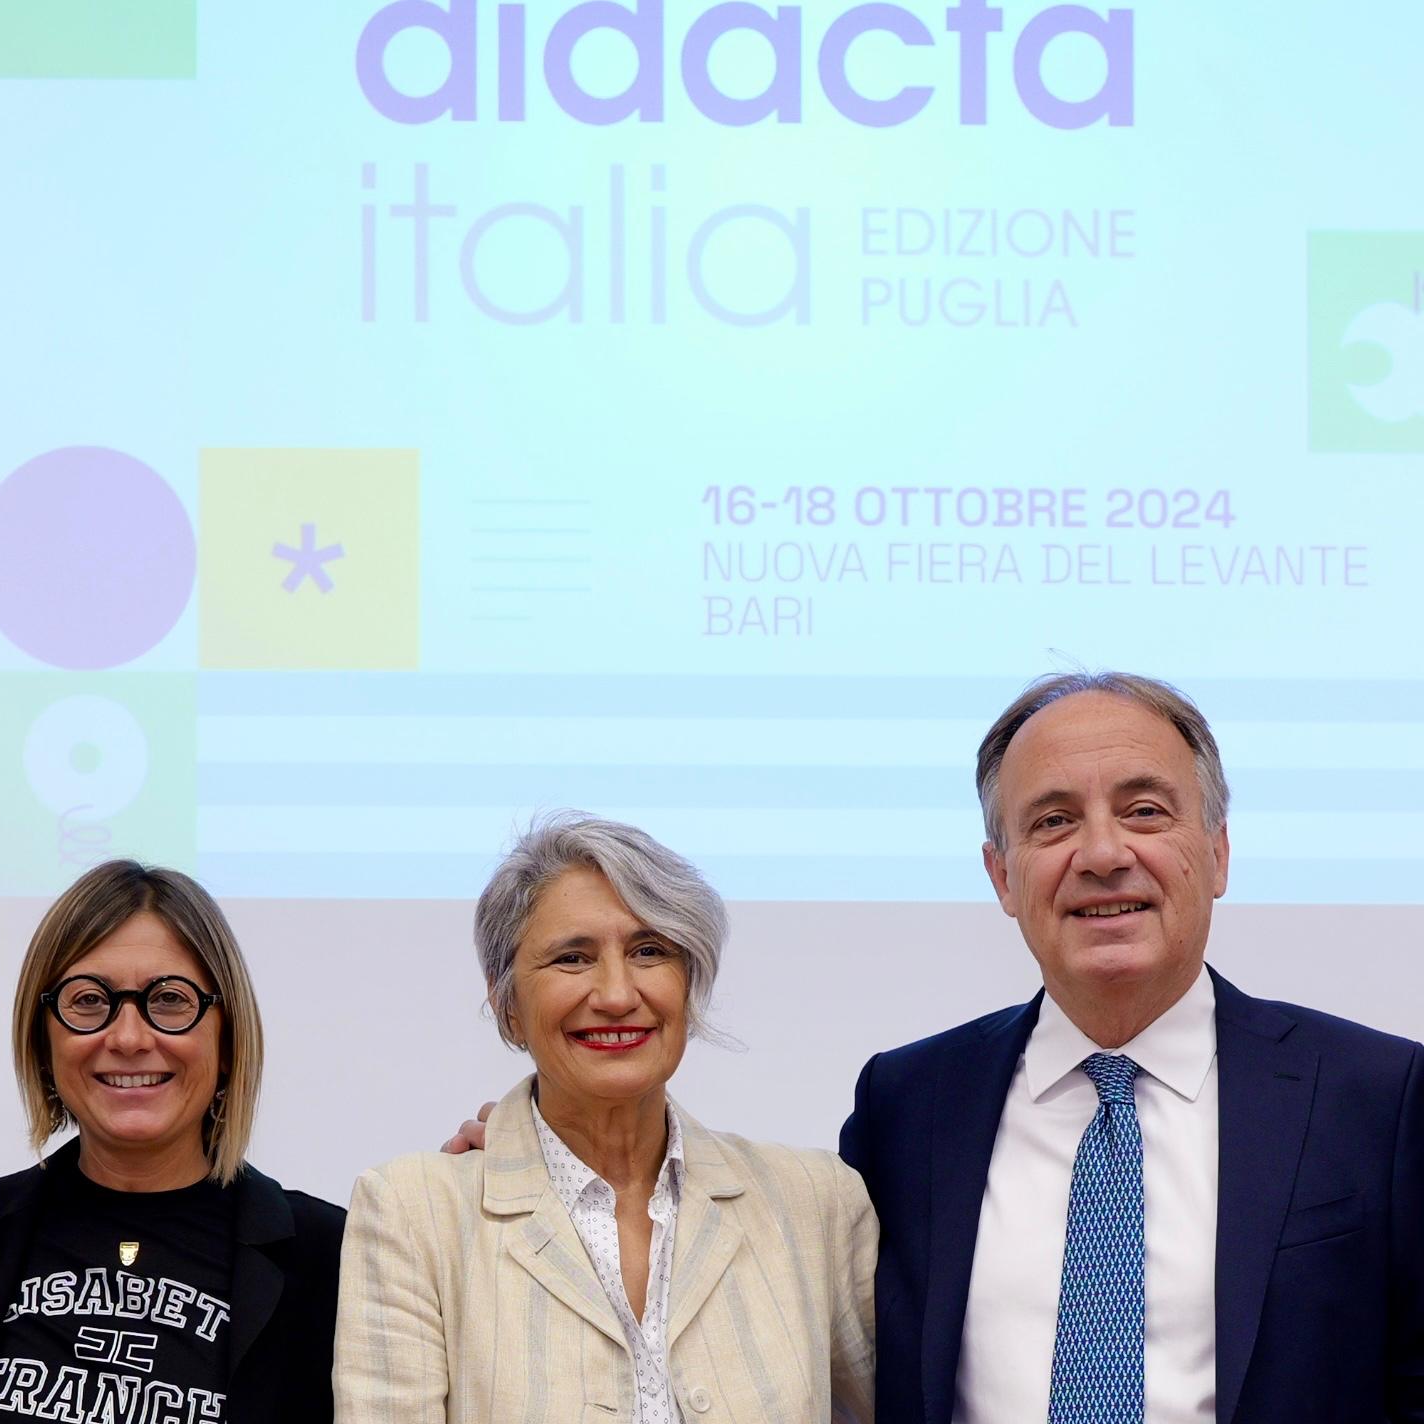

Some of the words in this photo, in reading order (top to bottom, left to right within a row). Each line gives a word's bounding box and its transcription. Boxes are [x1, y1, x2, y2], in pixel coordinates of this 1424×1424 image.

[360, 161, 813, 328] italia
[860, 207, 1137, 259] EDIZIONE
[860, 276, 1080, 329] PUGLIA
[701, 485, 836, 526] 16-18
[853, 487, 1089, 528] OTTOBRE
[1105, 488, 1237, 530] 2024
[701, 542, 869, 584] NUOVA
[886, 543, 1023, 585] FIERA
[1040, 544, 1133, 586] DEL
[1151, 545, 1370, 587] LEVANTE
[701, 596, 814, 637] BARI
[3, 1267, 231, 1343] ISABET
